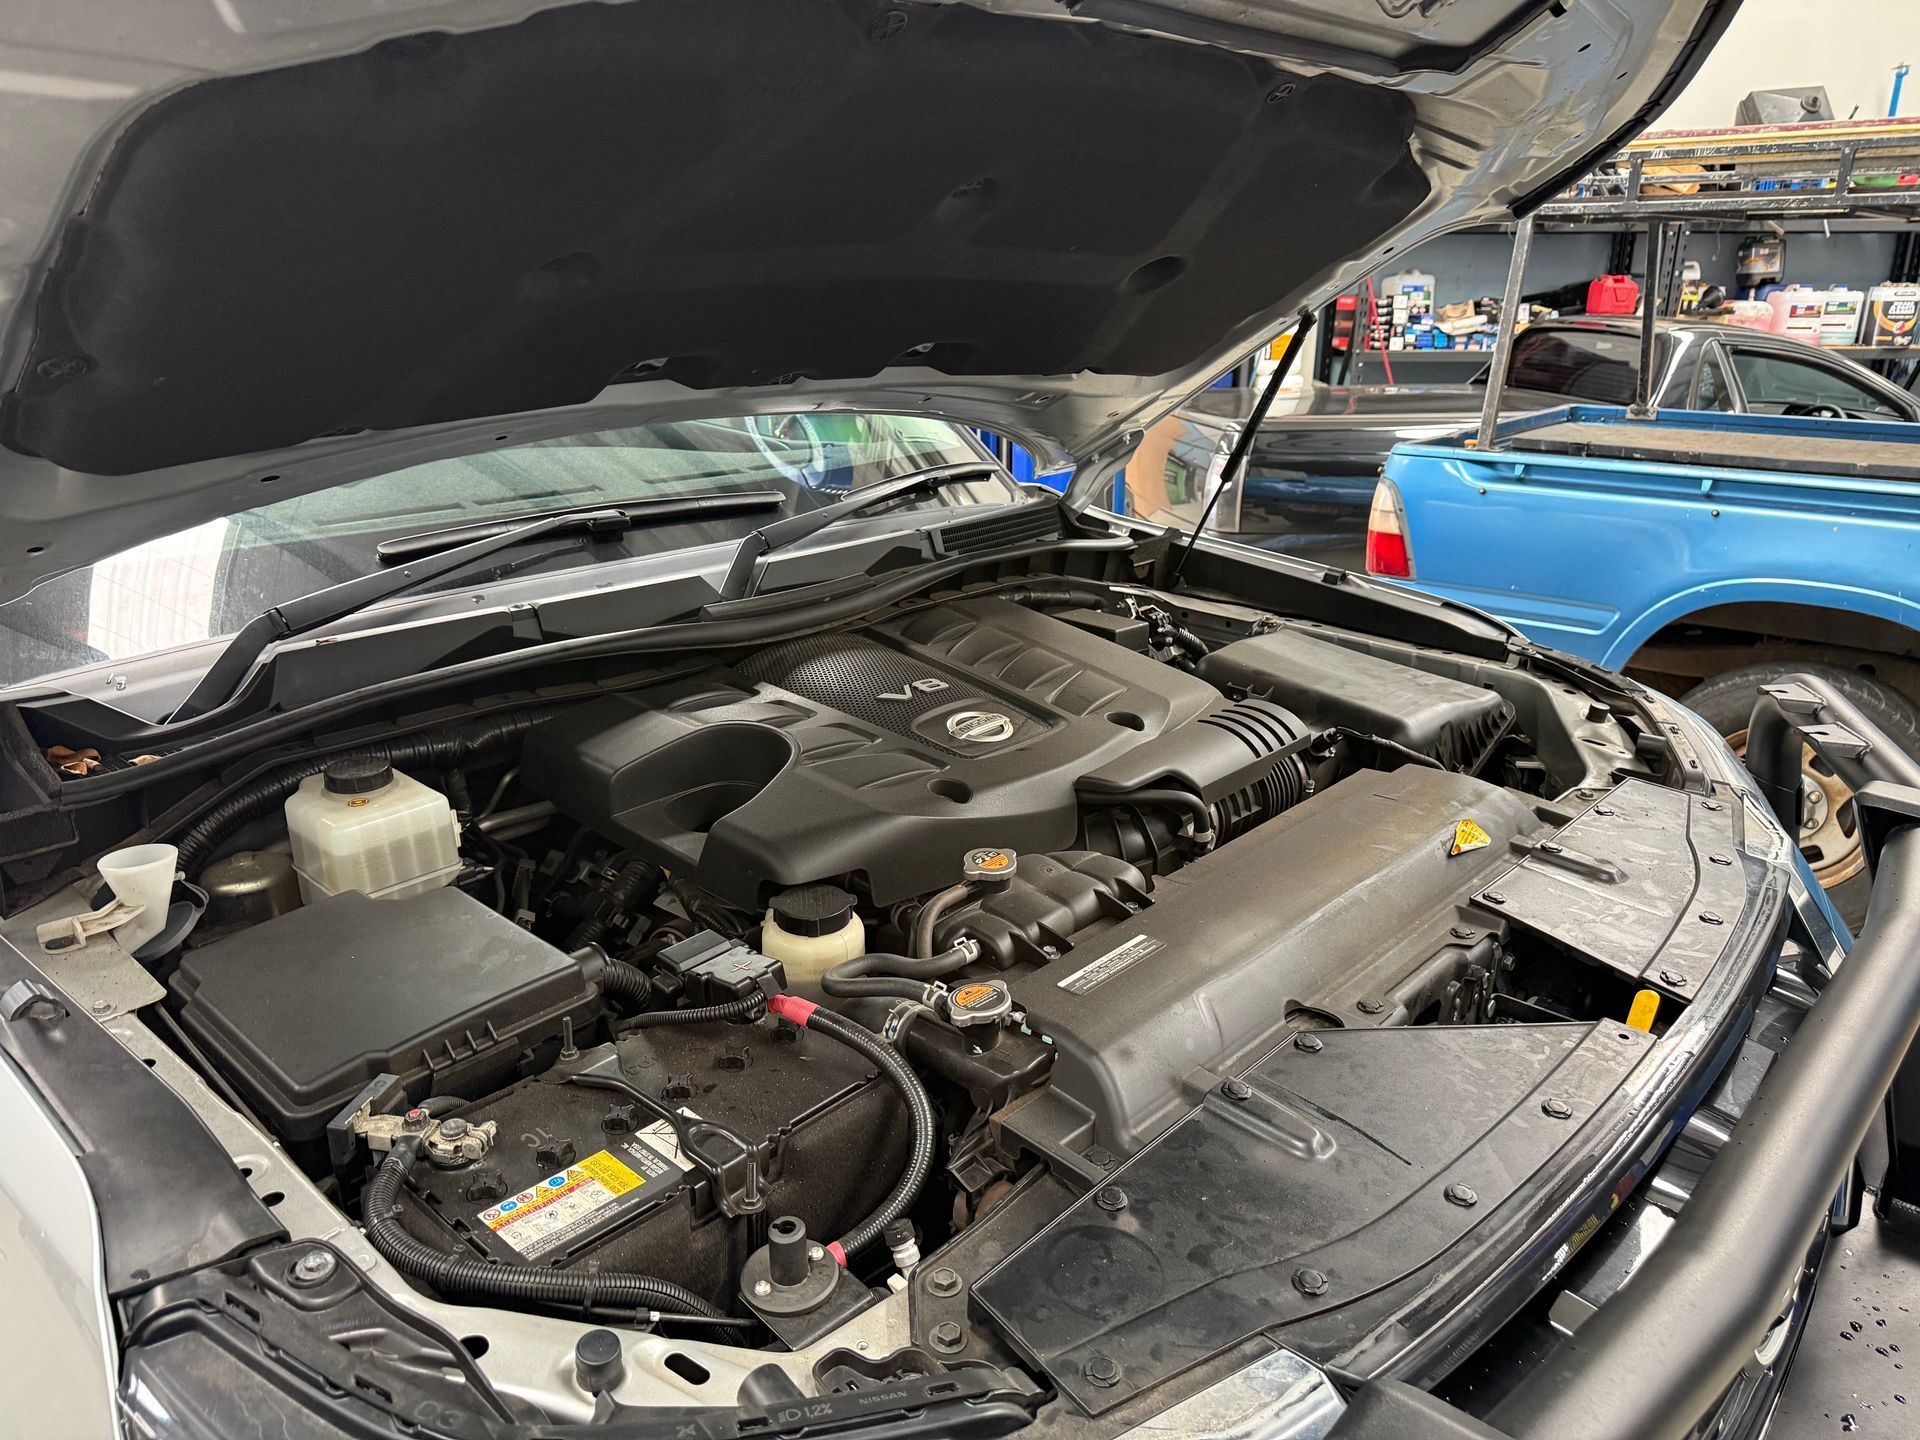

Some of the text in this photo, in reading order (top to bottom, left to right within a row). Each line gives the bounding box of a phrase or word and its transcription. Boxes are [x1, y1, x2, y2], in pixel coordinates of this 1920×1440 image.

[876, 678, 950, 700] V8
[958, 714, 1004, 733] NISSAN
[859, 1390, 908, 1406] NISSAN
